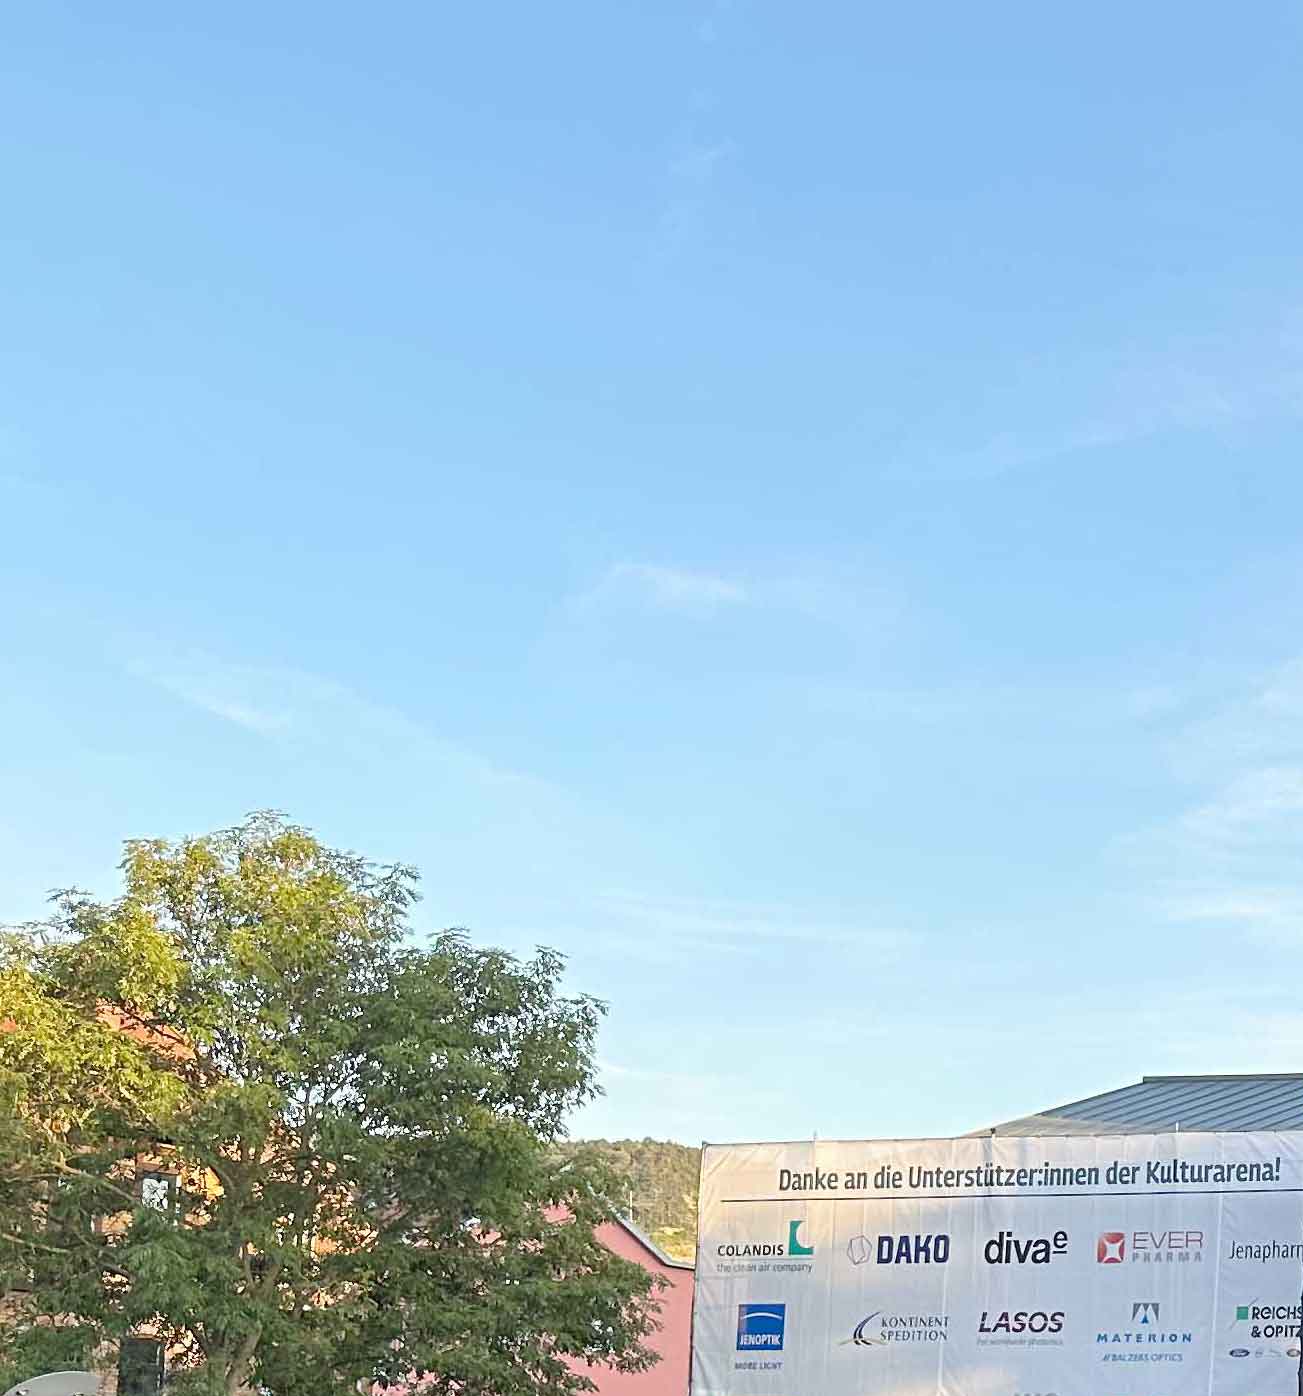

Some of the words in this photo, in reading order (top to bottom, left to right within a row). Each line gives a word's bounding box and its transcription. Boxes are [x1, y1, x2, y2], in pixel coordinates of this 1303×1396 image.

[779, 1167, 839, 1192] Danke
[844, 1172, 868, 1190] an
[873, 1164, 903, 1189] die
[908, 1162, 1100, 1189] Unterstützer:innen
[1106, 1160, 1139, 1186] der
[1146, 1156, 1281, 1185] Kulturarena!
[1132, 1230, 1204, 1250] EVER
[717, 1243, 784, 1257] COLANDIS
[877, 1234, 950, 1265] DAKO
[1131, 1251, 1203, 1264] PHARMA
[773, 1263, 813, 1275] company
[880, 1316, 949, 1329] KONTINENT
[978, 1310, 1065, 1334] LASOS
[880, 1330, 948, 1341] SPEDITION
[1096, 1332, 1192, 1344] MATERION
[1251, 1325, 1261, 1338] &
[739, 1333, 782, 1346] JENOPTIK
